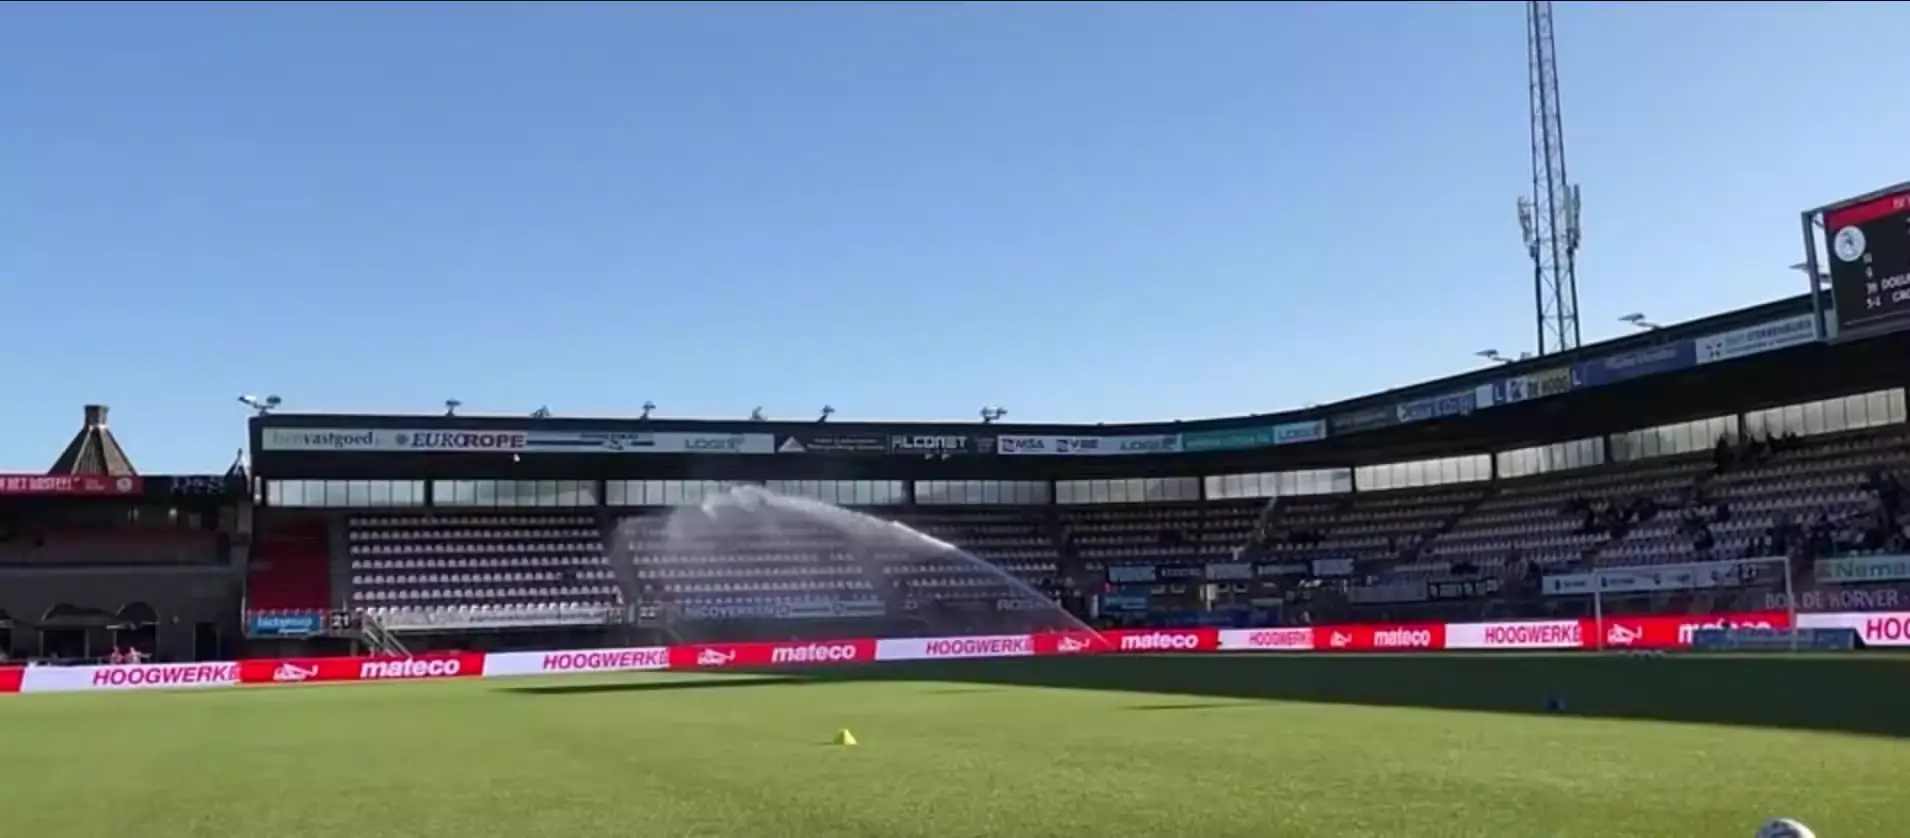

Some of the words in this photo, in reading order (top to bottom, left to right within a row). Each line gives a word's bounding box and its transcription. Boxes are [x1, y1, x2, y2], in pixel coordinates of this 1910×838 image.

[359, 657, 460, 678] mateco
[771, 643, 856, 663] mateco
[1120, 631, 1199, 649] mateco
[1373, 628, 1431, 647] mateco
